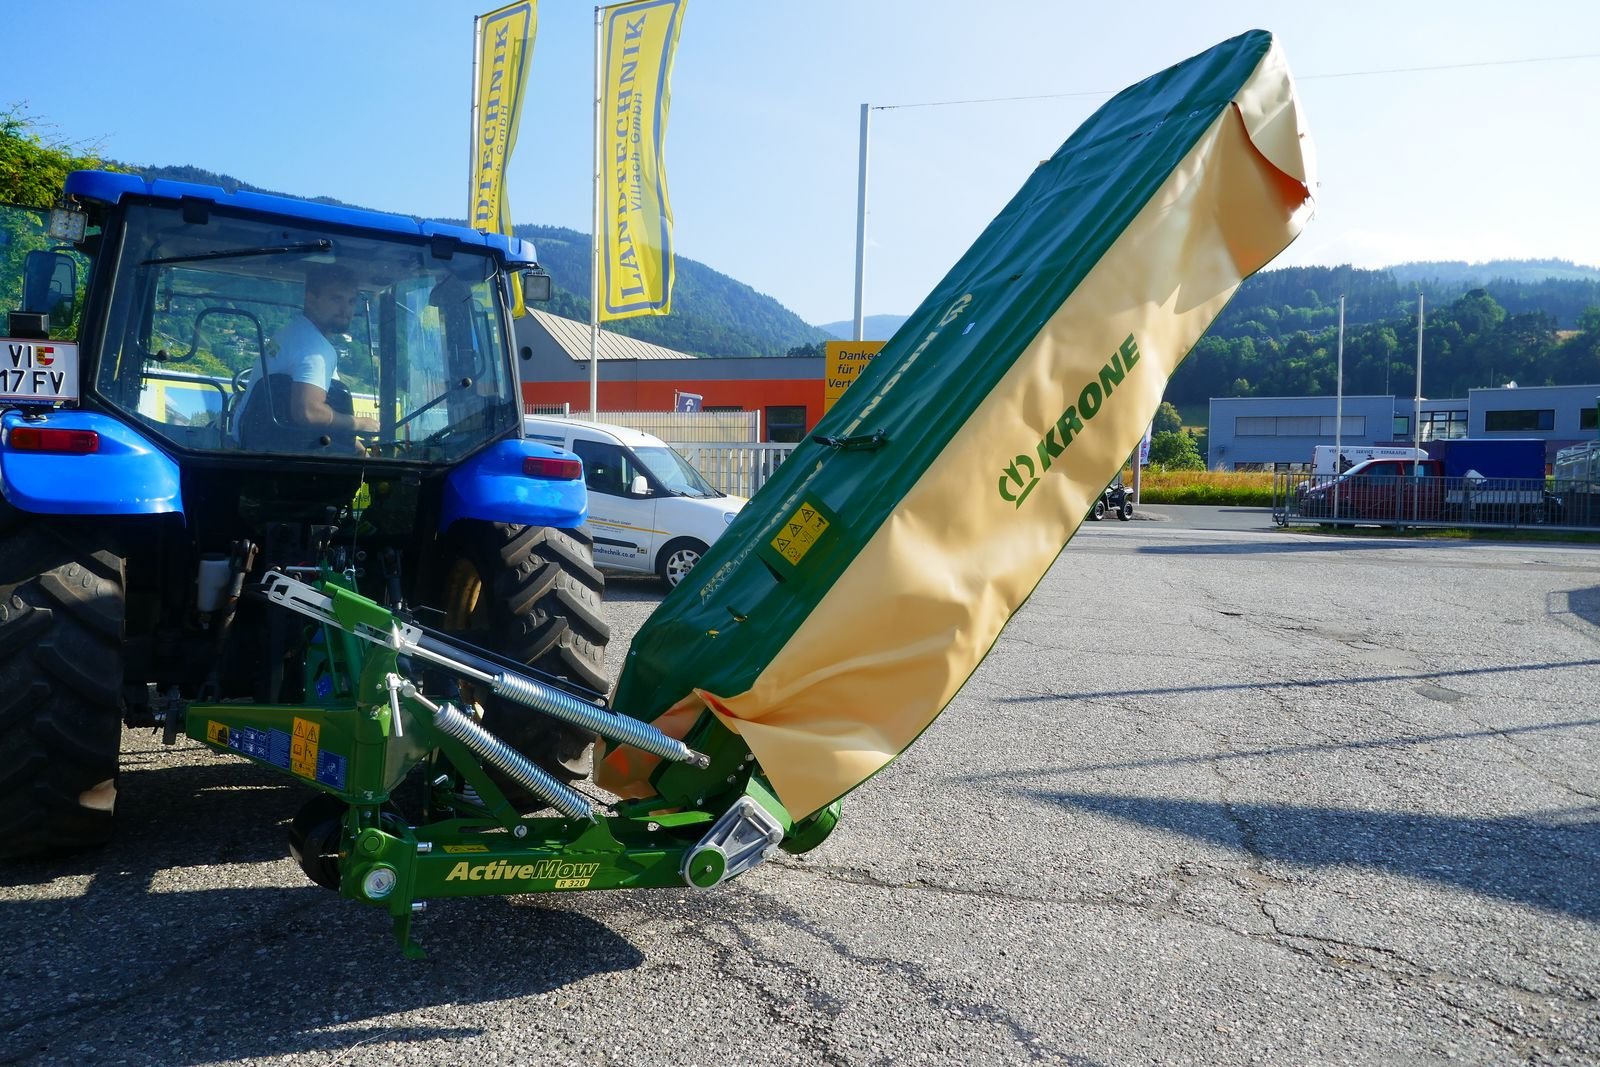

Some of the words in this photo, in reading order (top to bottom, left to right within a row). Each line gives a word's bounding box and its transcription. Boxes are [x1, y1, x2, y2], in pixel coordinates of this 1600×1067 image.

[475, 21, 510, 233] DTECHNIK
[496, 104, 509, 156] GmbH
[631, 92, 643, 144] GmbH
[617, 13, 647, 299] LANDTECHNIK
[631, 151, 642, 211] Villach
[9, 344, 33, 369] VI
[839, 350, 876, 361] Danke
[837, 363, 855, 375] für
[32, 371, 65, 395] FV
[828, 378, 852, 388] Vert
[1036, 332, 1141, 473] KRONE
[592, 546, 636, 559] andtechnik.co.at
[445, 859, 600, 881] ActiveMow
[559, 880, 566, 888] R
[568, 879, 586, 888] 320
